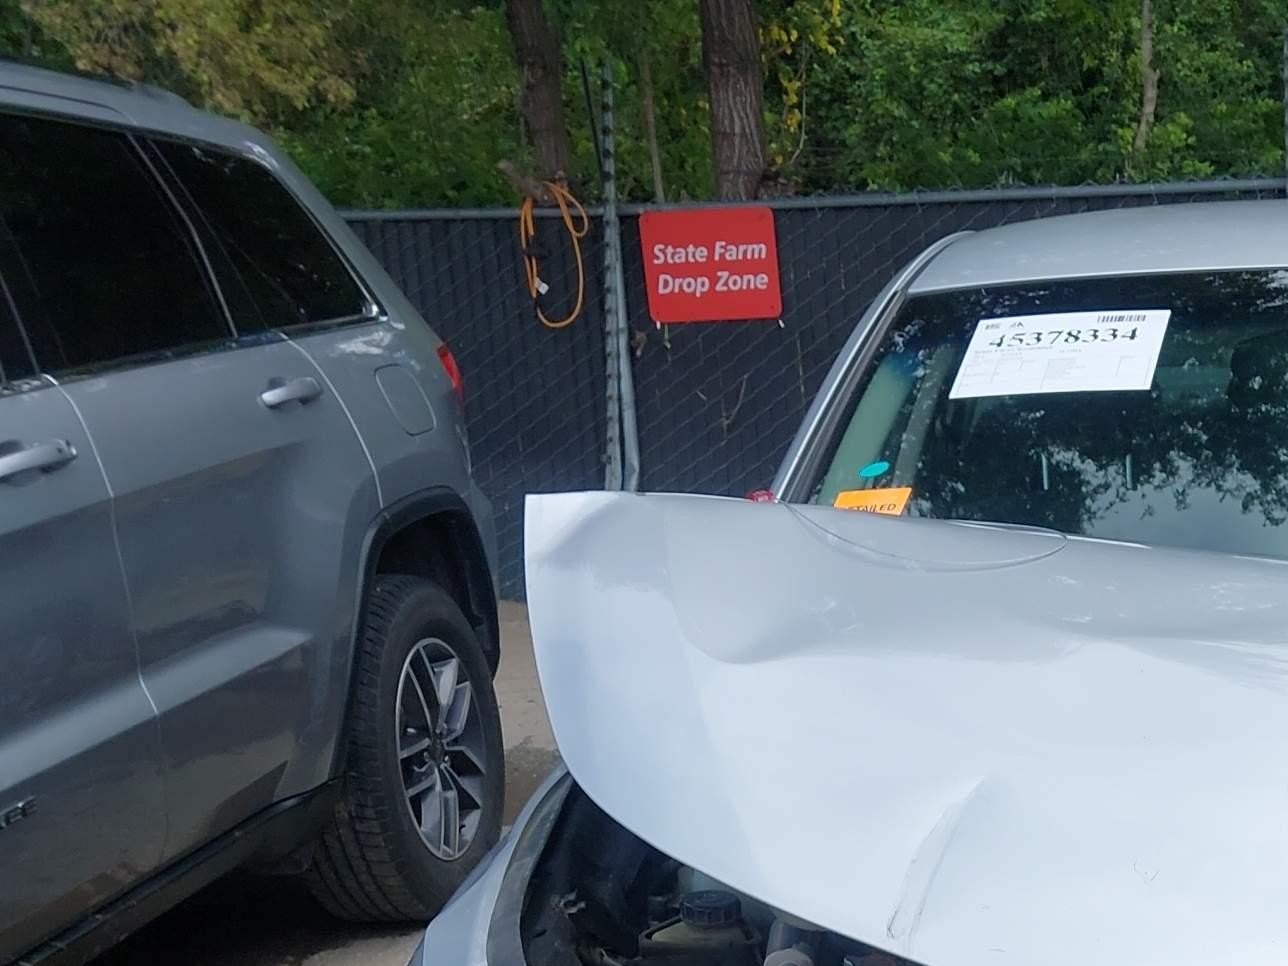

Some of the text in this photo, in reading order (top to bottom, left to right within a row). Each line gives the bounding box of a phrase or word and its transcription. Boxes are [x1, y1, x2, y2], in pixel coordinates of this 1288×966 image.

[653, 240, 767, 265] State Farm
[657, 270, 769, 298] Drop Zone
[988, 326, 1138, 348] 45378334
